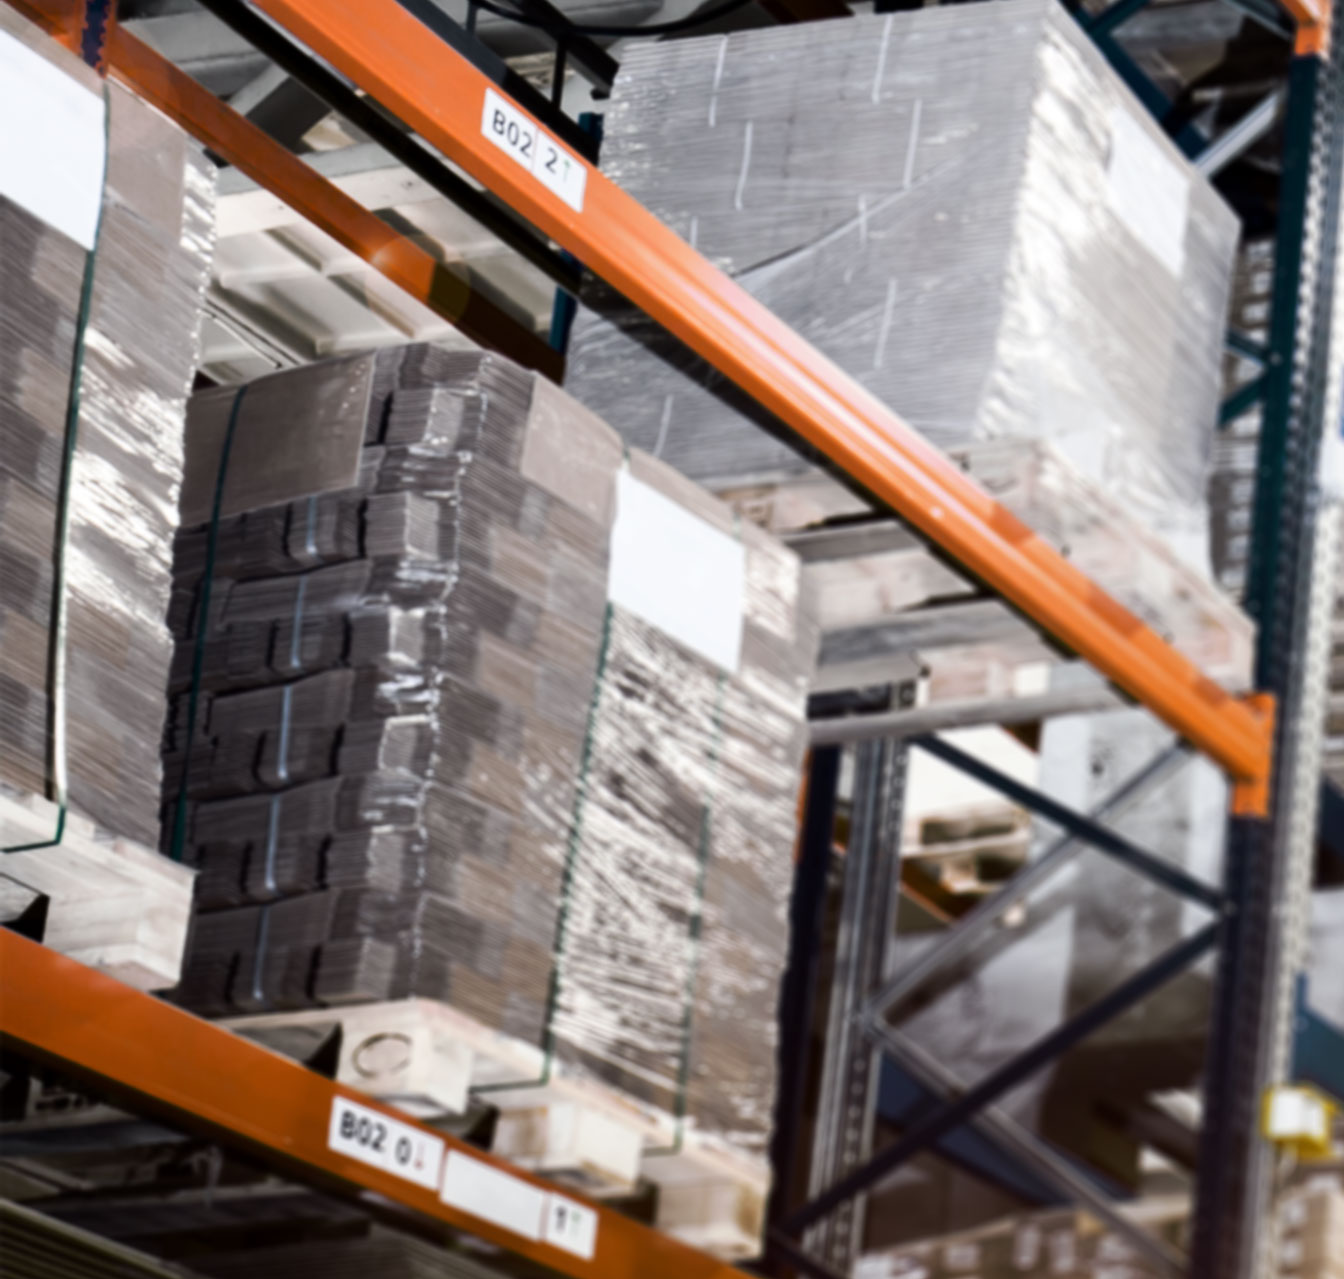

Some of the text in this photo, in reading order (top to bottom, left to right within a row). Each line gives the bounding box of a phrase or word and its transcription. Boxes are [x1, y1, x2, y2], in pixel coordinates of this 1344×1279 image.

[491, 107, 559, 175] B02 2
[338, 1109, 387, 1154] B02
